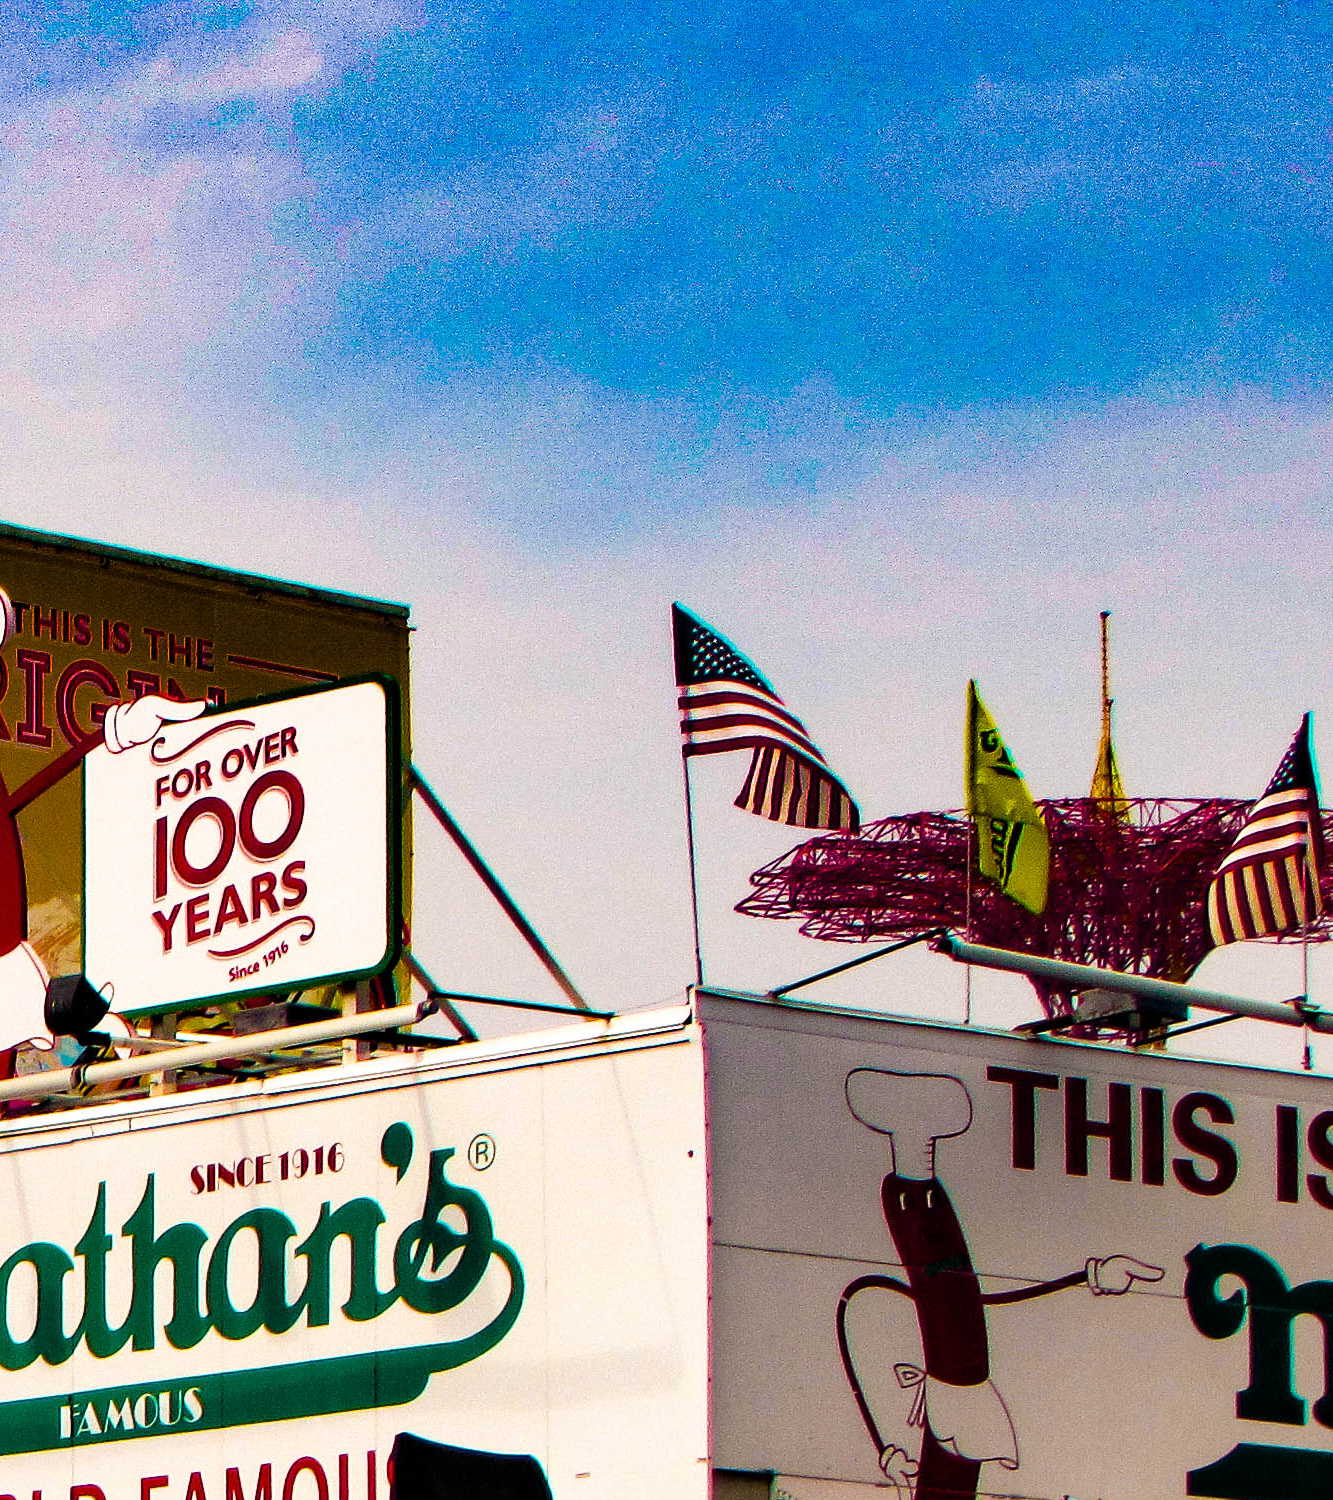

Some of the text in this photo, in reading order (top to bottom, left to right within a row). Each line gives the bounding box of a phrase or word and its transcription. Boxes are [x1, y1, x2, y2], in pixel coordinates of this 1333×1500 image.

[12, 600, 217, 672] THIS IS THE
[154, 726, 299, 808] FOR OVER
[154, 769, 307, 904] 100
[151, 861, 309, 956] YEARS
[228, 941, 290, 982] Since 1916
[986, 1065, 1239, 1198] THIS
[190, 1143, 346, 1198] SINCE 1916
[58, 1386, 205, 1442] FAMOUS
